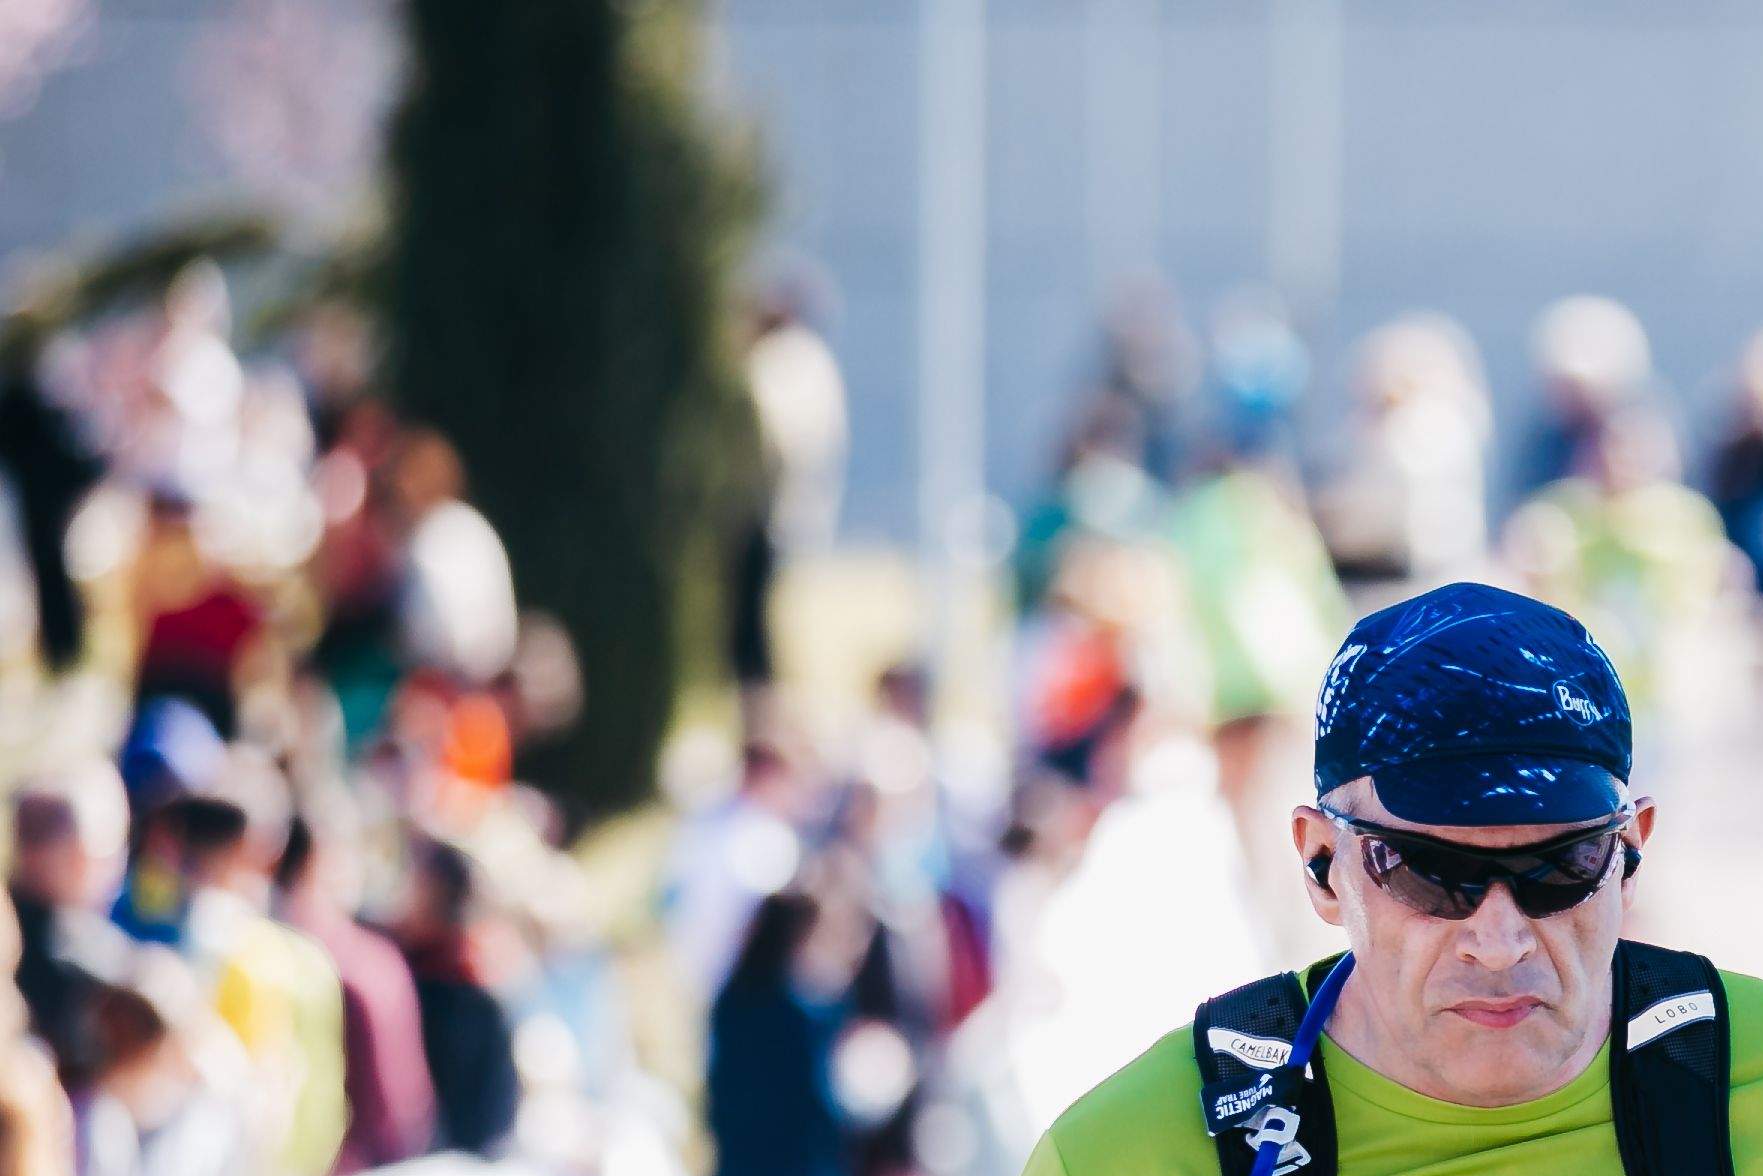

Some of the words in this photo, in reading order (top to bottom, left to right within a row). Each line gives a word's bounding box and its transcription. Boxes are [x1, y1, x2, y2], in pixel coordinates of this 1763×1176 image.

[1654, 1002, 1698, 1024] LOBO
[1230, 1038, 1288, 1064] CAMELBAK
[1215, 1085, 1273, 1120] MAGNETIC
[1216, 1094, 1238, 1106] TRAP
[1238, 1086, 1257, 1100] TUBE
